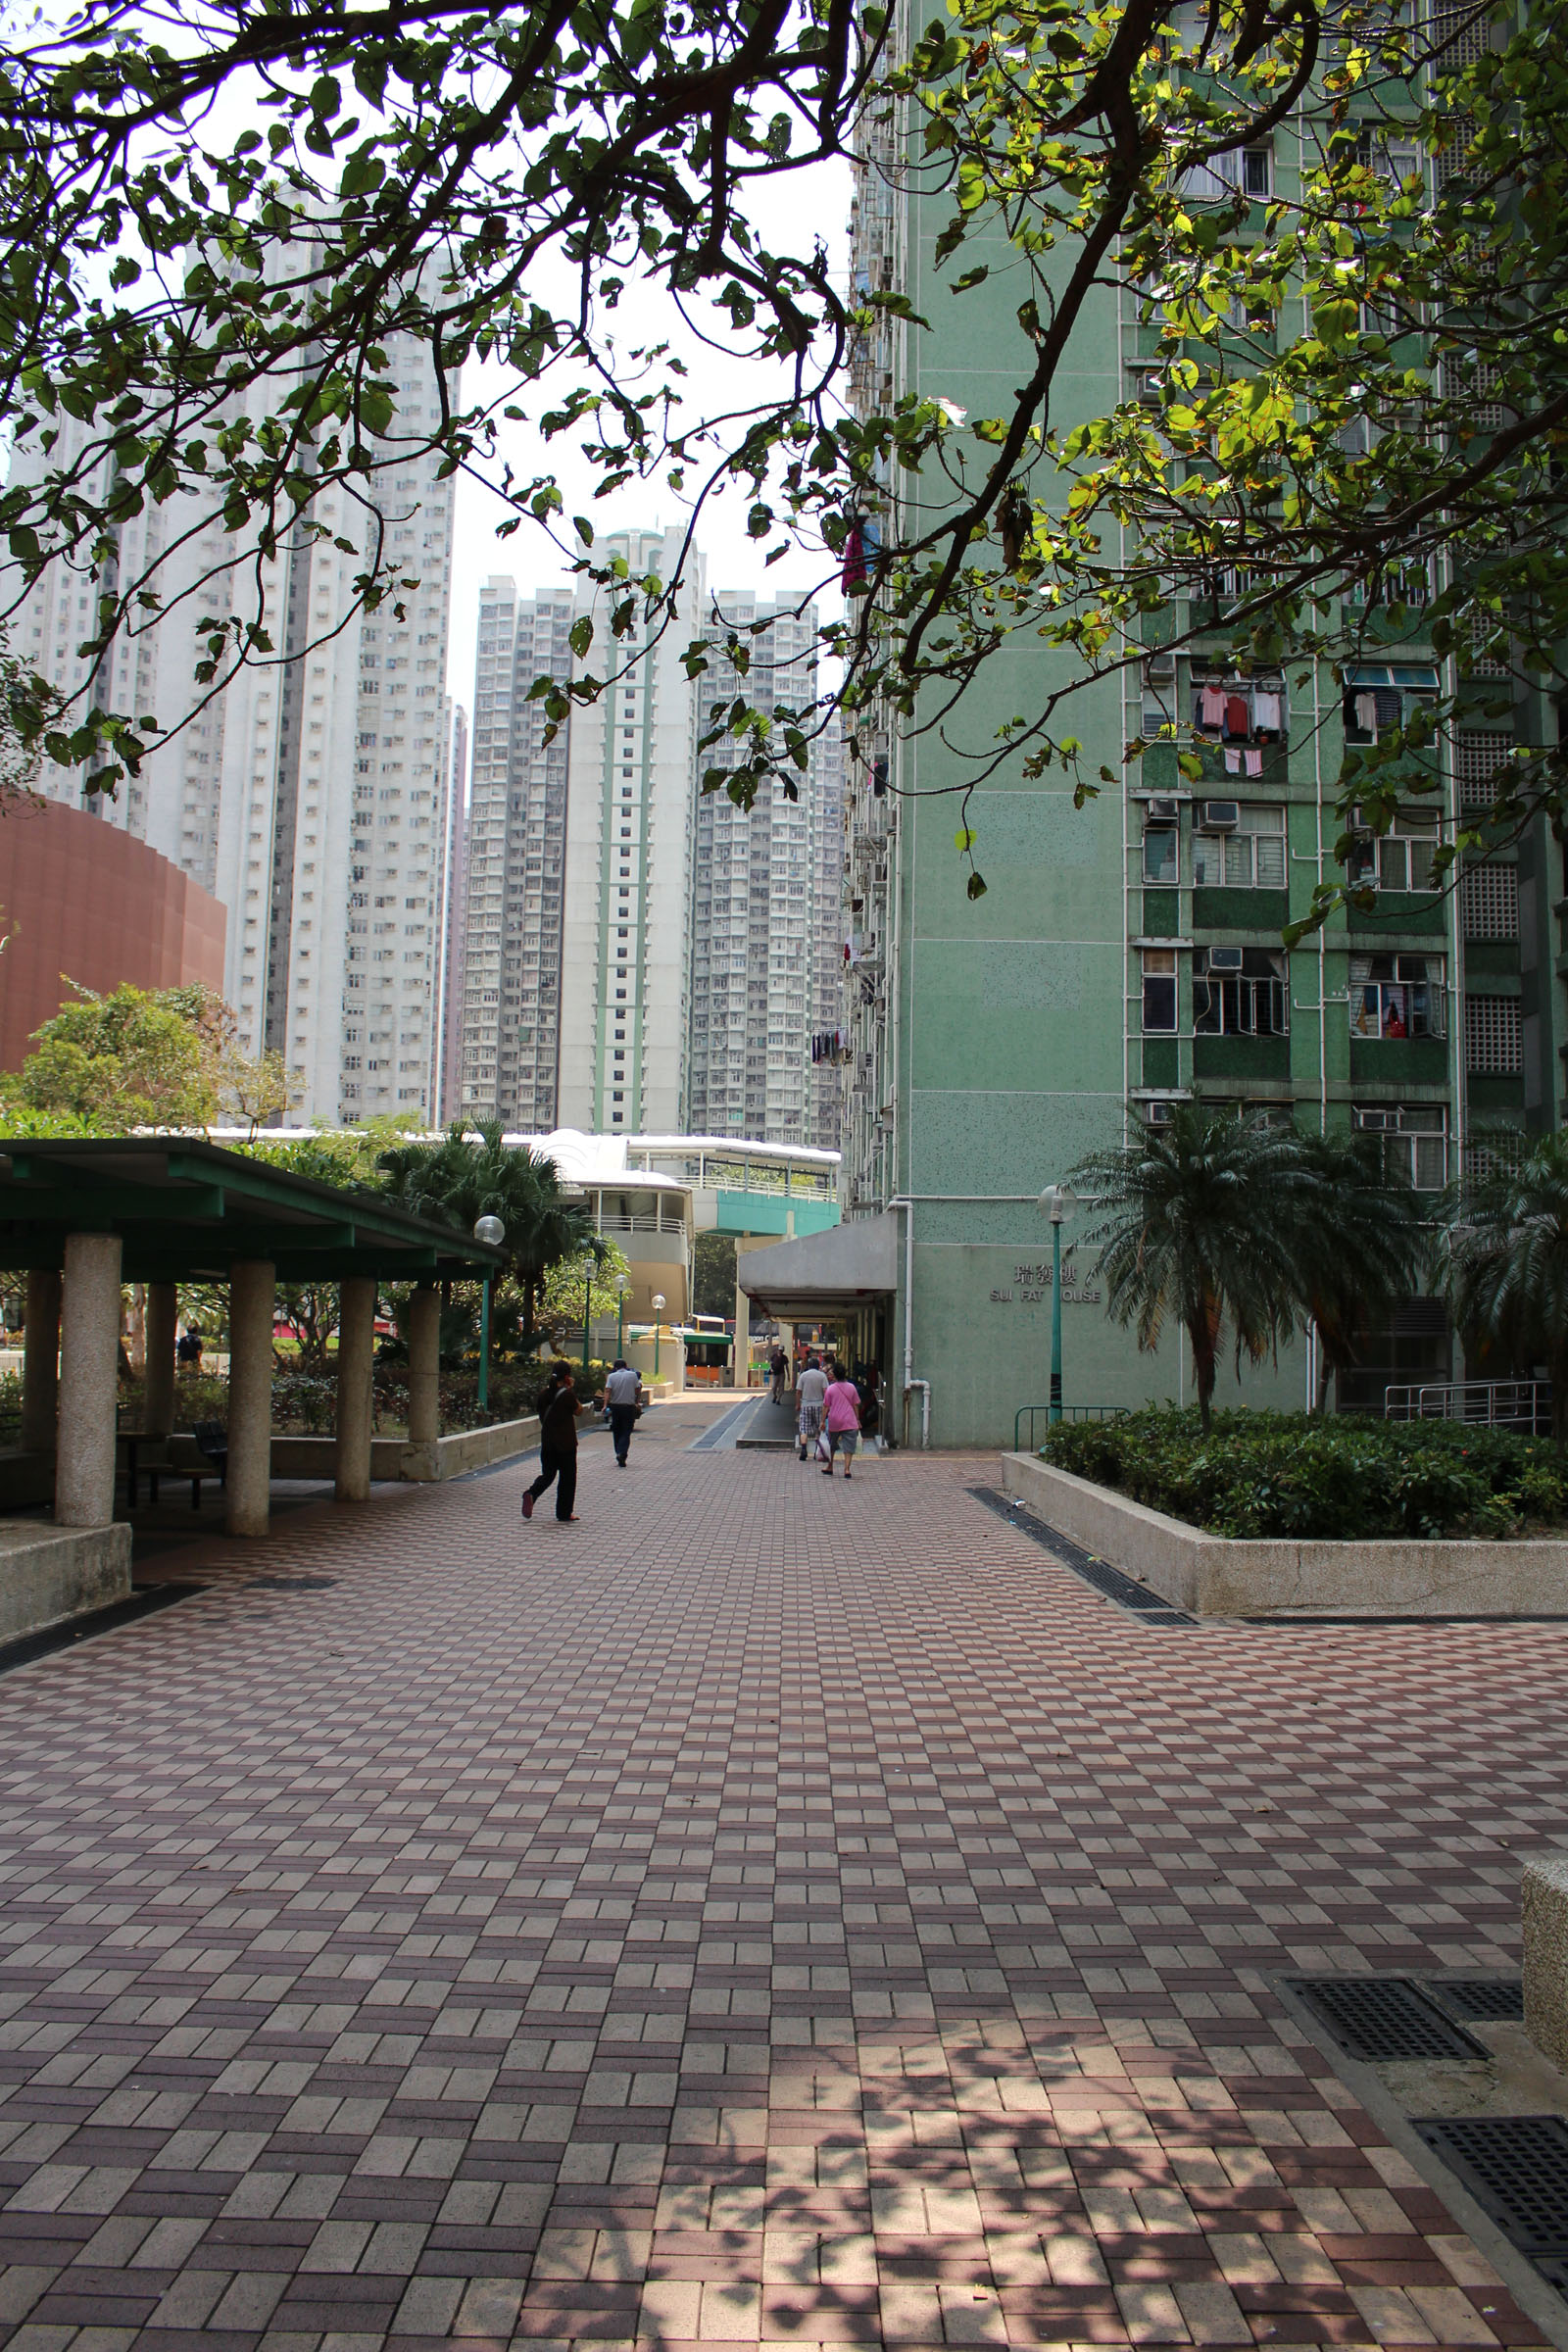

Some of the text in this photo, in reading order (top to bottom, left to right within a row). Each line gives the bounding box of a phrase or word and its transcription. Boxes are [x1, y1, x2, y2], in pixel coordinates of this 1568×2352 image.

[1013, 1264, 1077, 1286] 瑞發樓
[990, 1289, 1102, 1303] SUI FAT OUSE
